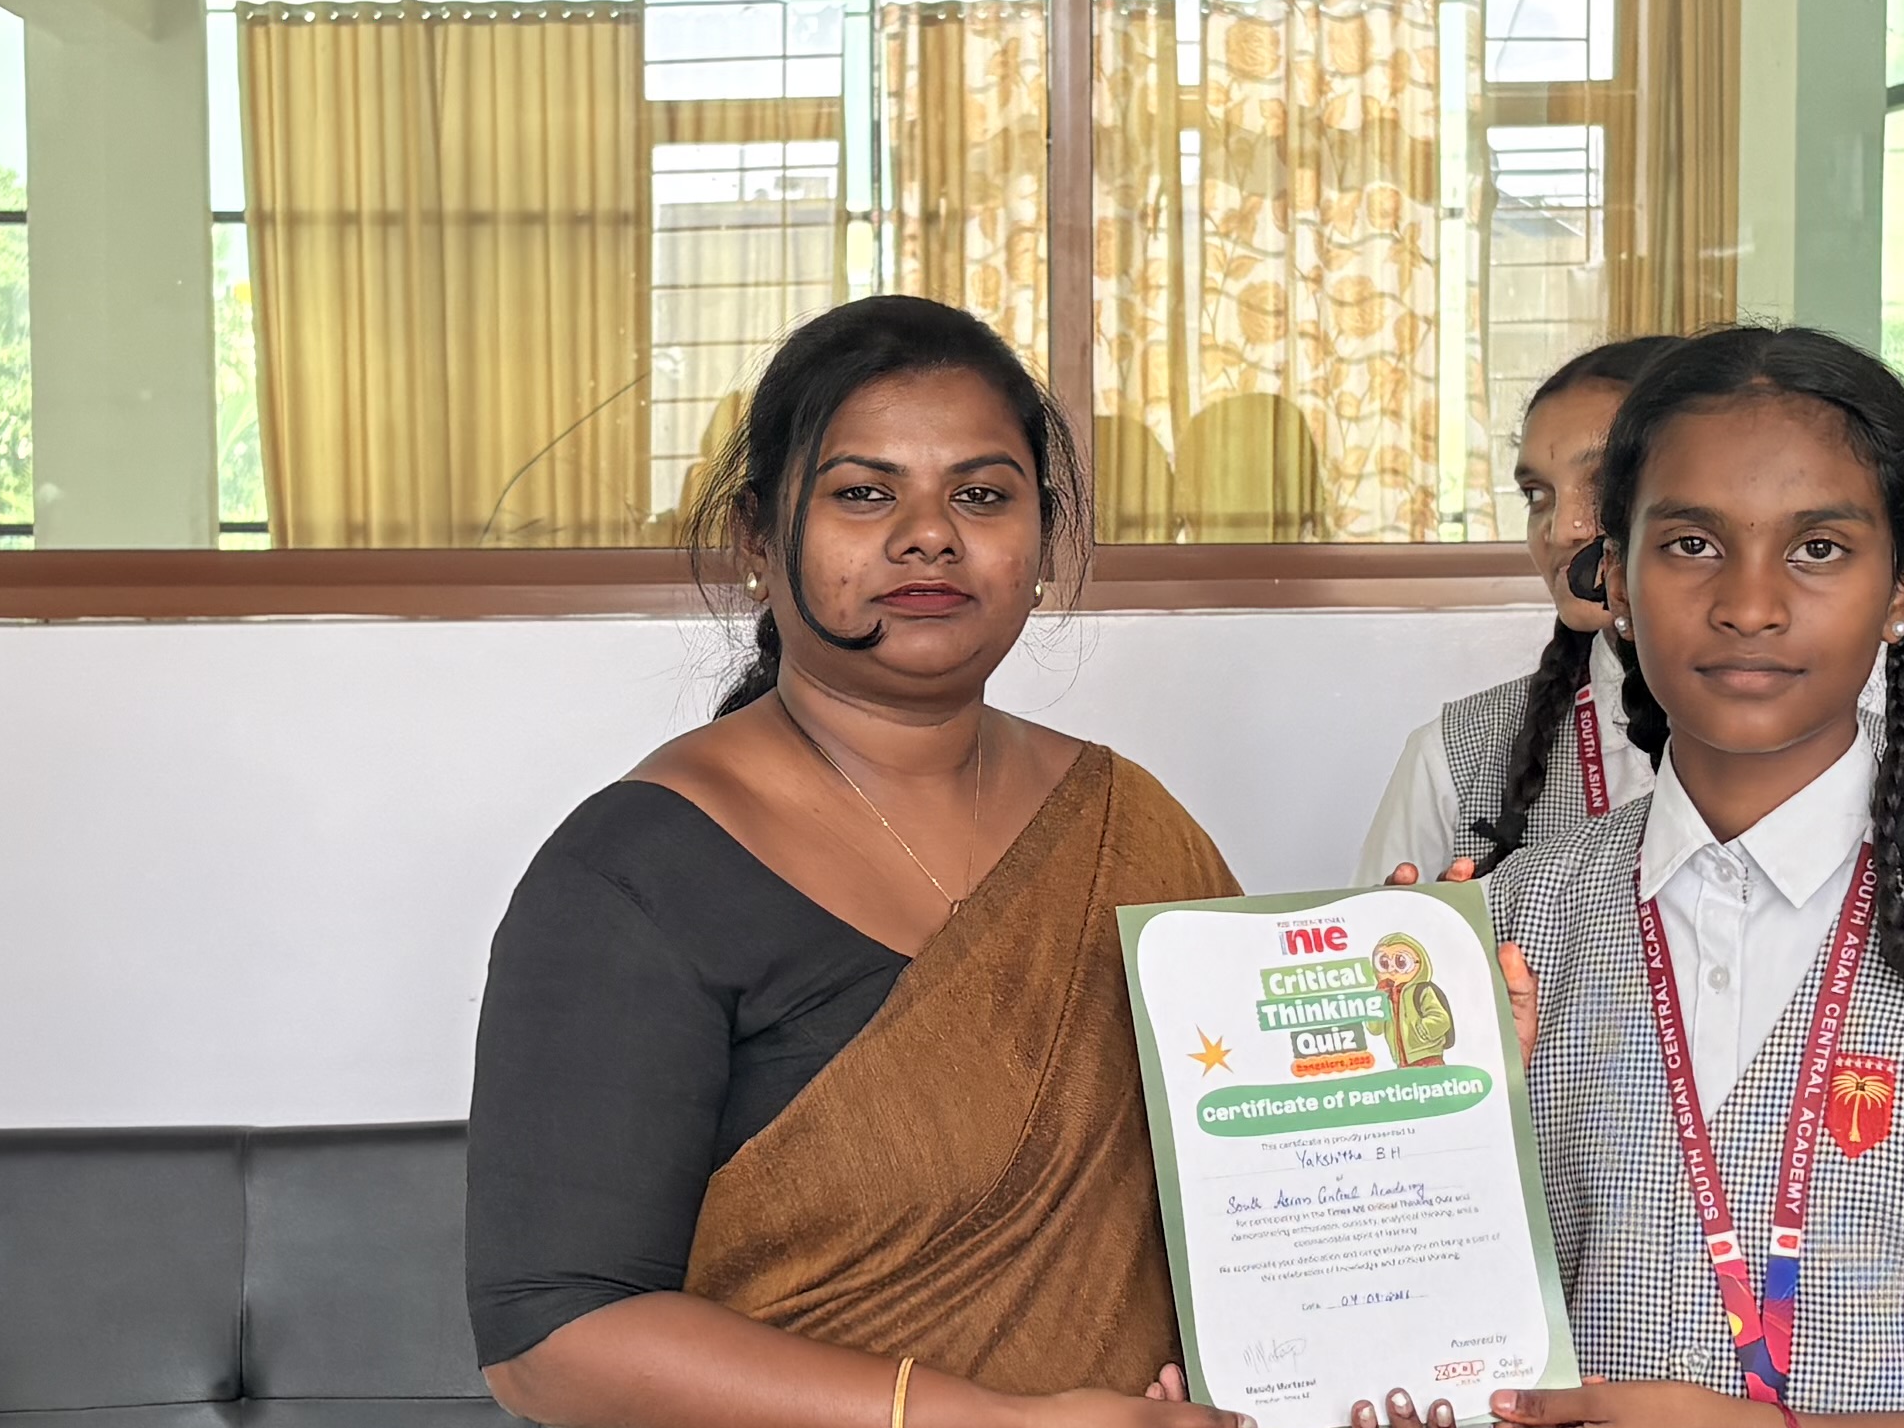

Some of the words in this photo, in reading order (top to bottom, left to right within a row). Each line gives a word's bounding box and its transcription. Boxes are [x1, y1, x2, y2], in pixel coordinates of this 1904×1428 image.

[1579, 710, 1594, 756] SOUTH
[1587, 760, 1603, 809] ASIAN
[1849, 858, 1878, 925] SOUTH
[1640, 903, 1664, 969] ACADE
[1831, 932, 1860, 994] ASIAN
[1261, 995, 1385, 1027] Thinking
[1269, 963, 1366, 995] Critical
[1296, 1027, 1357, 1055] Quiz
[1653, 975, 1682, 1070] CENTRAL
[1805, 1003, 1841, 1099] CENTRAL
[1203, 1096, 1318, 1123] Certificate
[1323, 1091, 1345, 1109] of
[1349, 1078, 1484, 1107] Participation
[1671, 1076, 1698, 1141] ASIAN
[1688, 1148, 1719, 1221] SOUTH
[1786, 1106, 1816, 1215] ACADEMY
